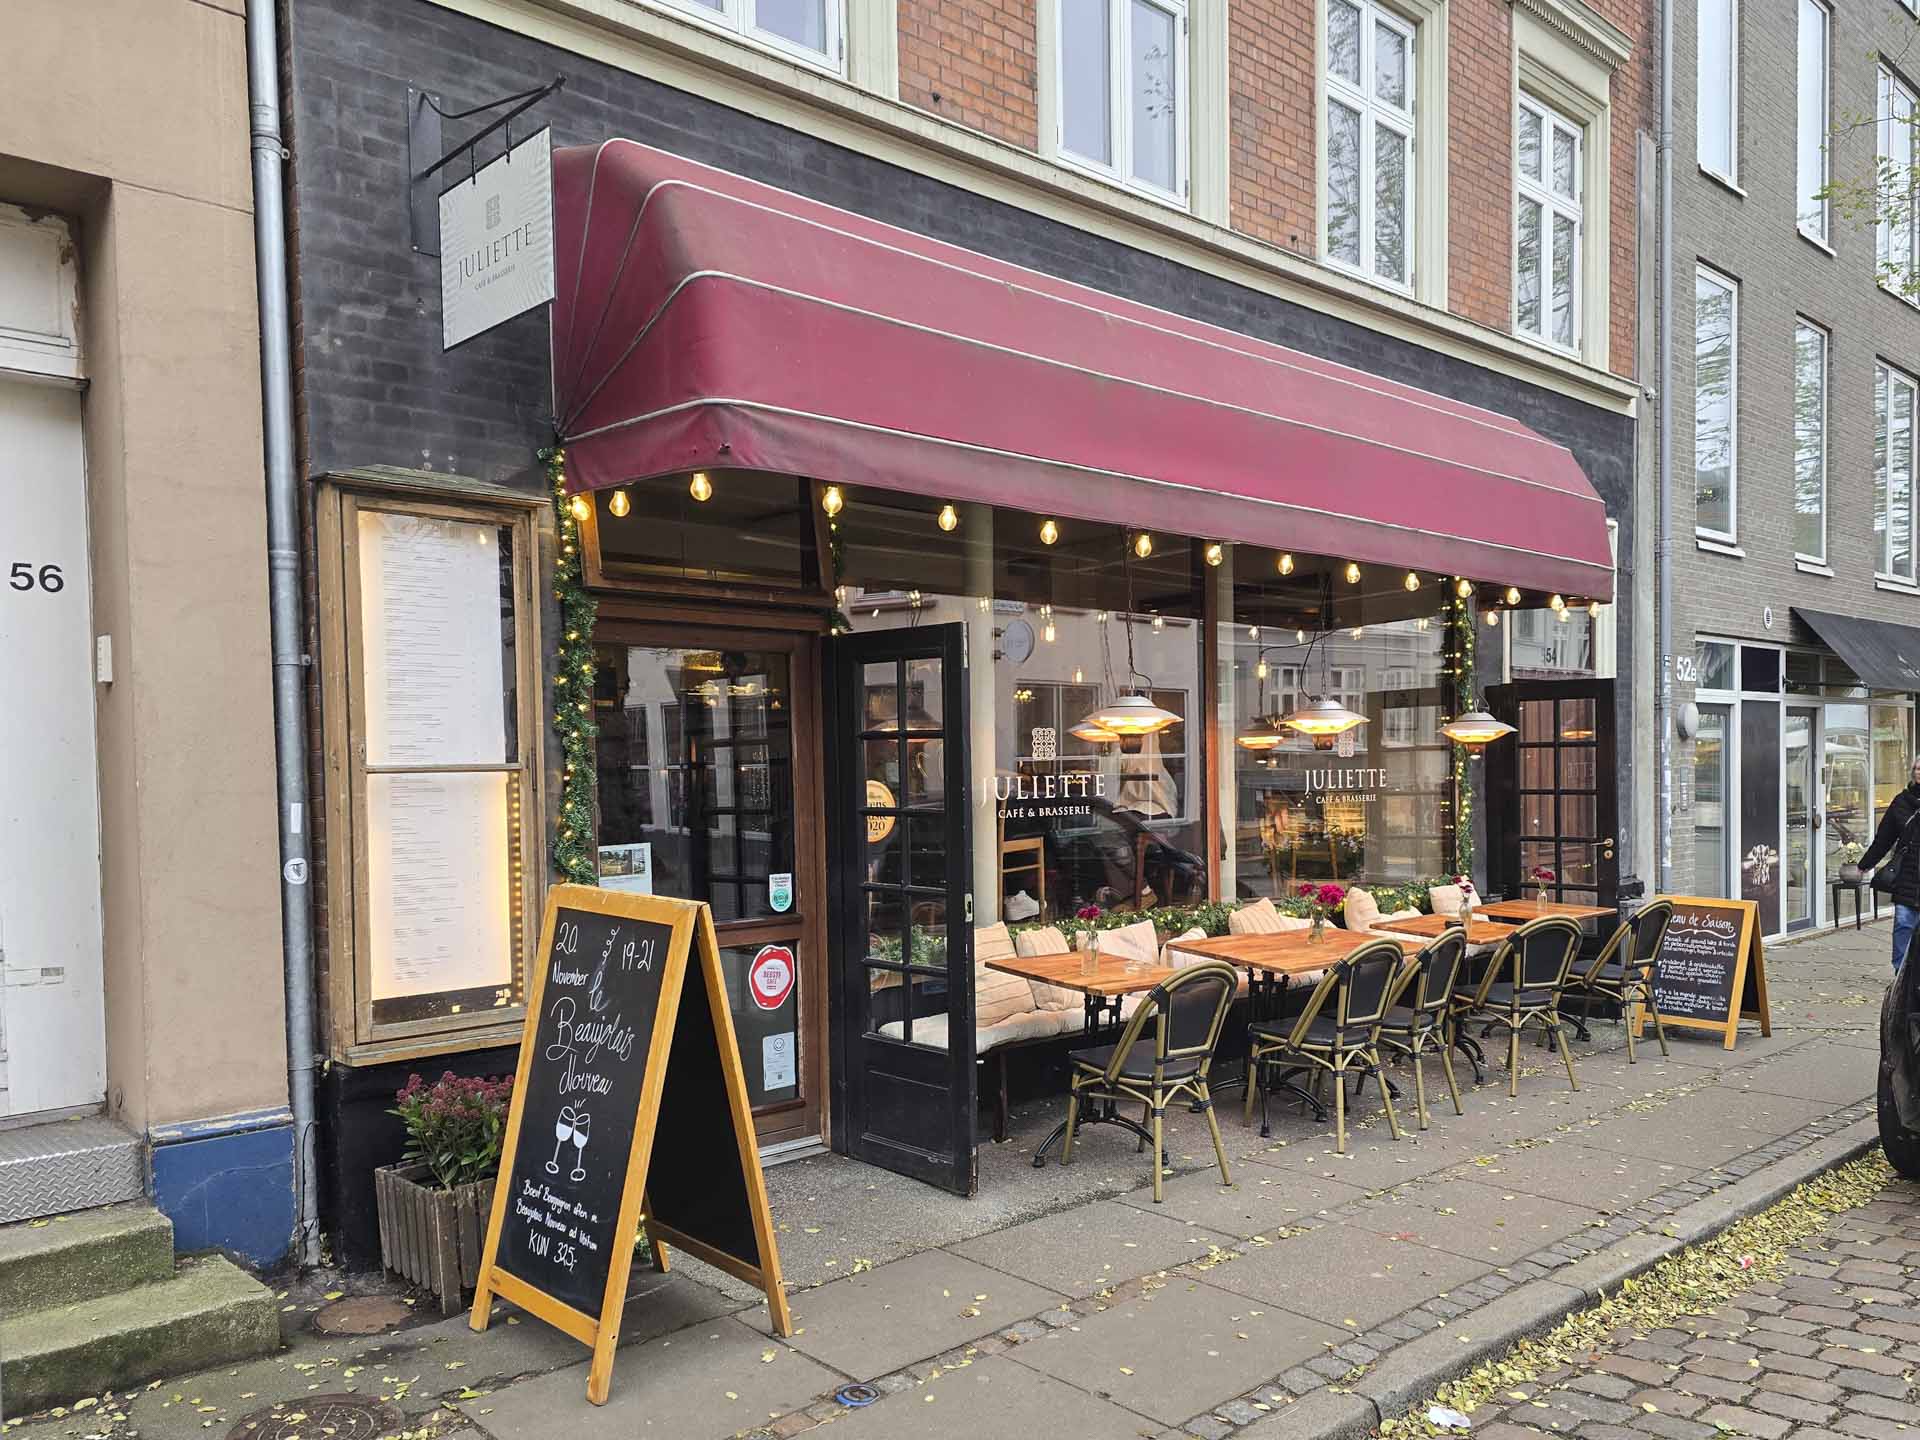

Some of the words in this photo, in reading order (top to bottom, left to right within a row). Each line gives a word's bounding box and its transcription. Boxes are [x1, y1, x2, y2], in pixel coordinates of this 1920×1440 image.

[458, 222, 532, 288] JULIETTE
[9, 562, 64, 593] 56
[1545, 647, 1557, 666] 54
[979, 773, 1106, 809] JULIETTE
[1305, 768, 1387, 796] JULIETTE
[1342, 793, 1377, 802] BRASSERIE
[998, 807, 1025, 819] CAFÉ
[1027, 807, 1036, 817] &
[1039, 805, 1091, 817] BRASSERIE
[1670, 914, 1686, 925] enu
[1688, 912, 1699, 926] de
[1701, 913, 1735, 933] Saison
[621, 939, 655, 972] 19-21
[552, 961, 589, 987] November
[546, 996, 635, 1064] Beaujolais
[528, 1228, 550, 1257] KUN
[568, 1226, 578, 1239] ad
